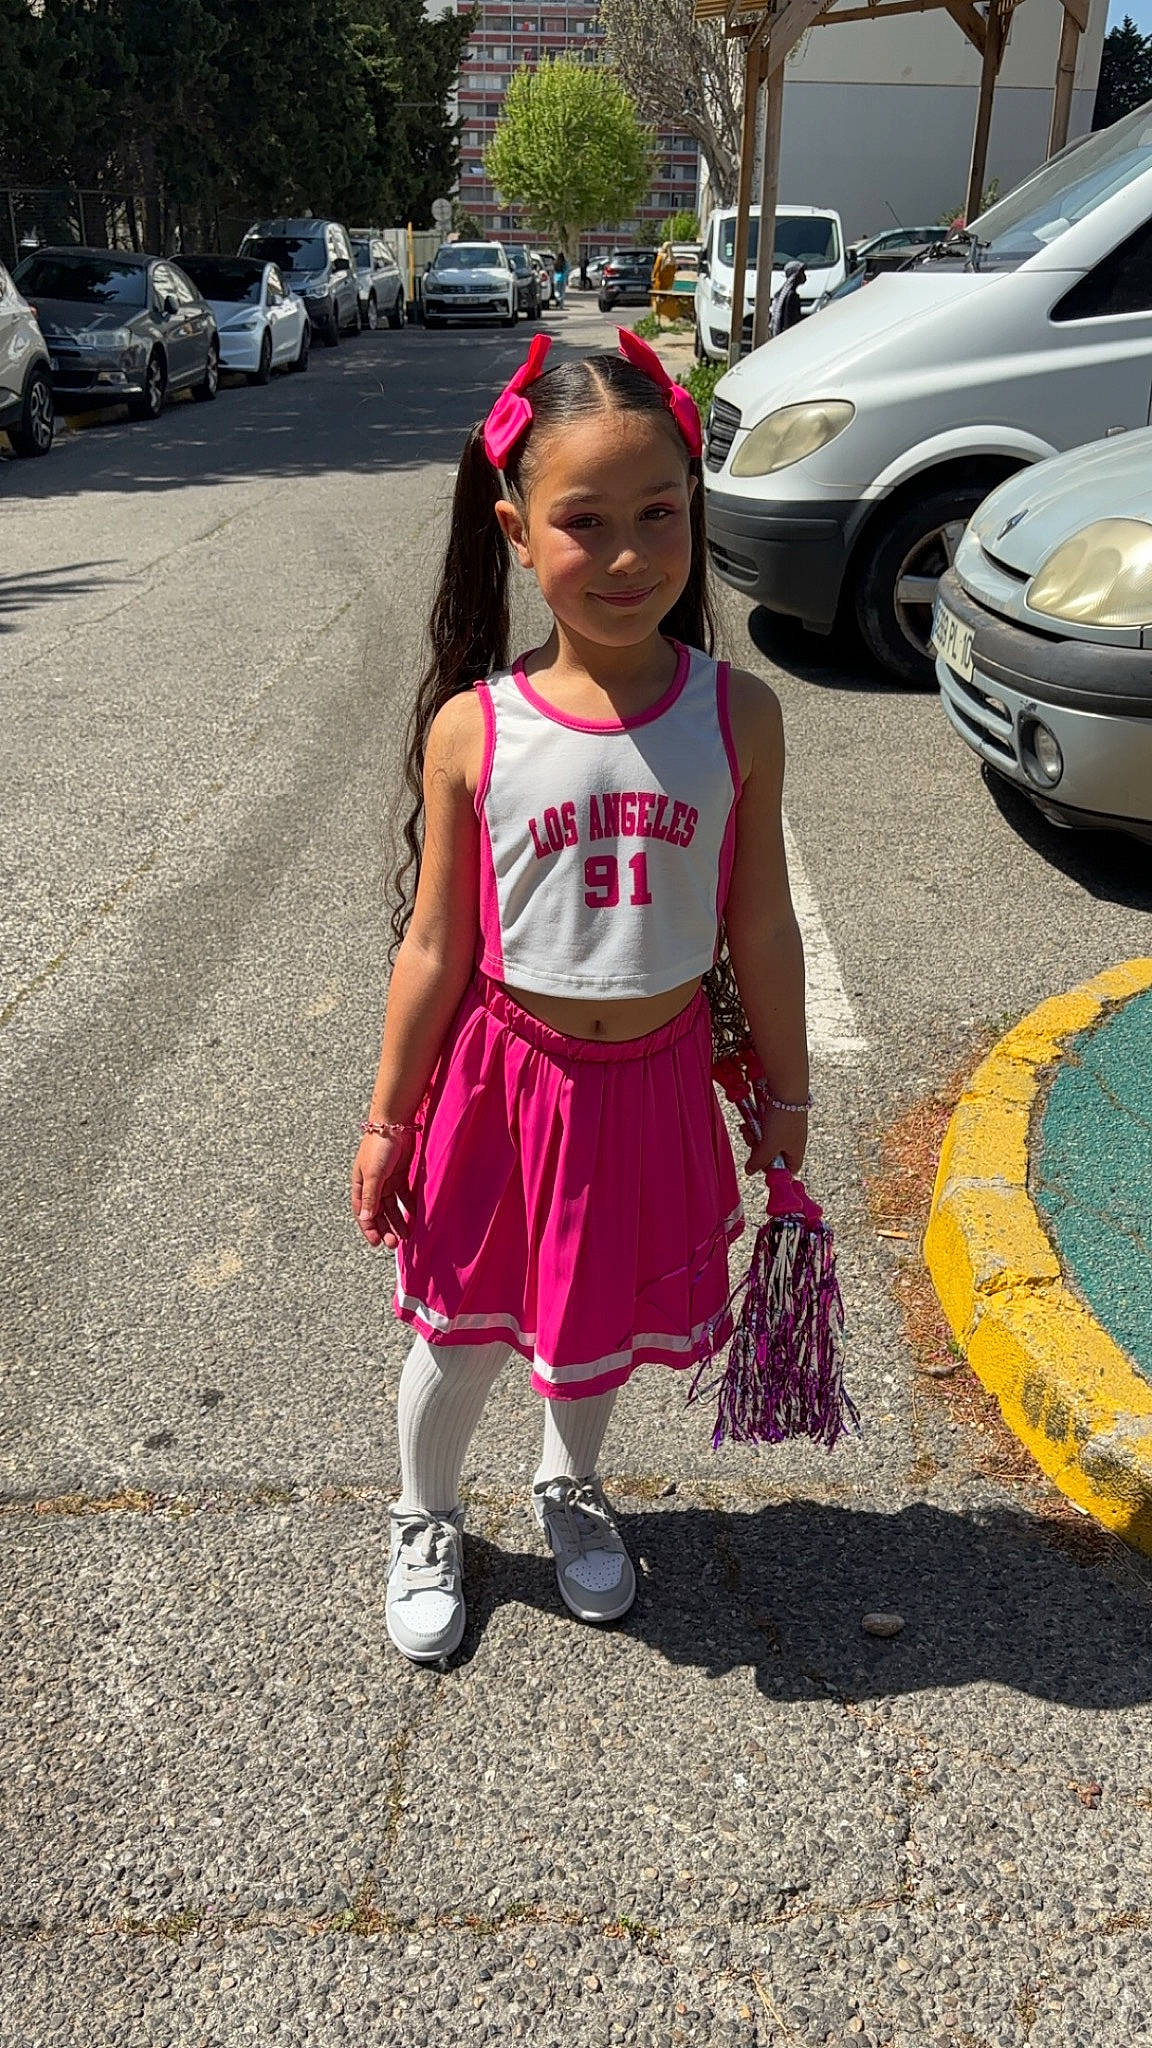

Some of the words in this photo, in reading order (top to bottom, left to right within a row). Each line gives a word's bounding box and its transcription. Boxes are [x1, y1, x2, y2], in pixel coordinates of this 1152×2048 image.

[528, 801, 579, 860] LOS
[589, 792, 699, 848] ANGELES
[584, 852, 653, 908] 91
